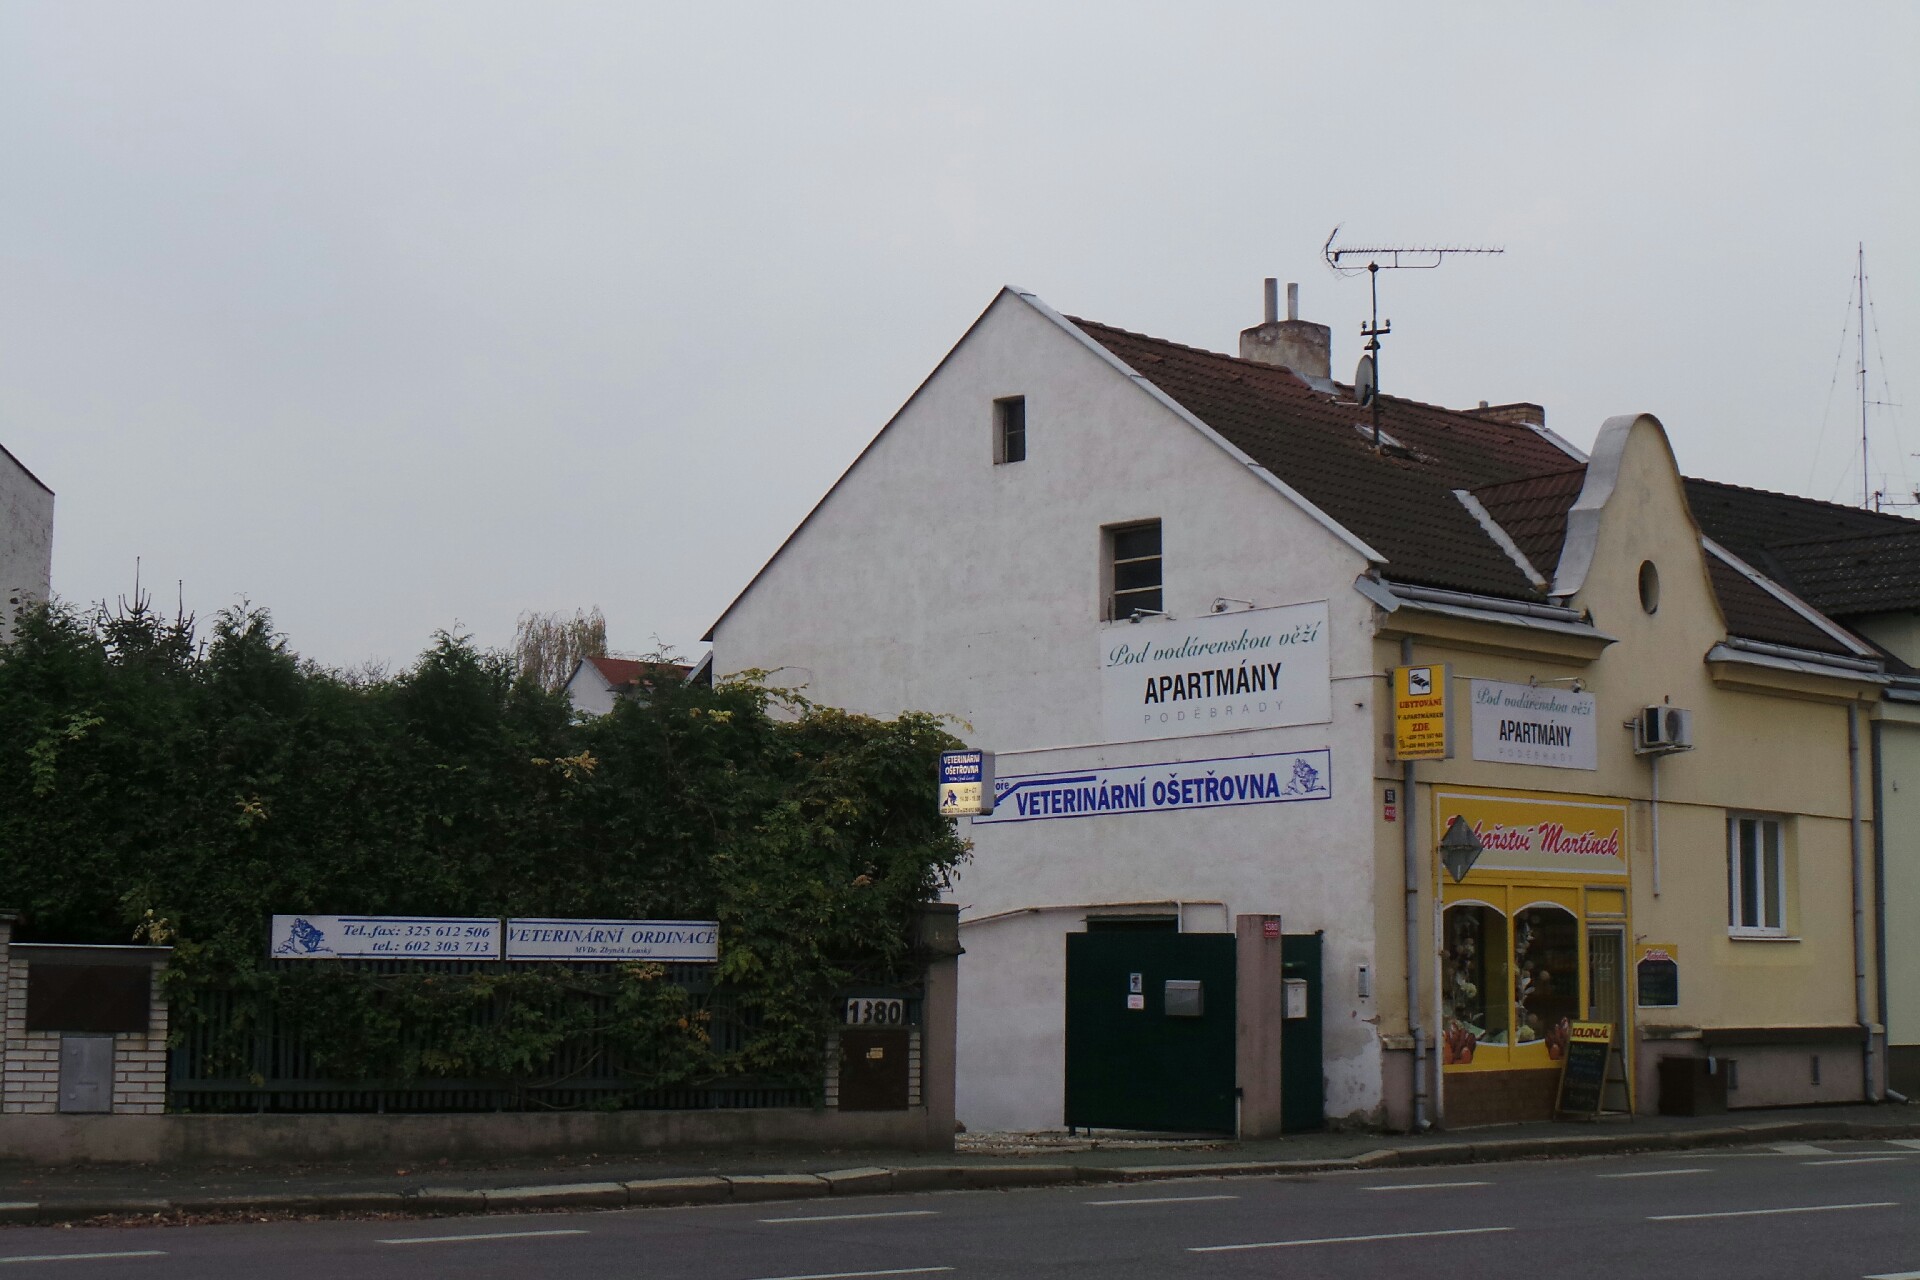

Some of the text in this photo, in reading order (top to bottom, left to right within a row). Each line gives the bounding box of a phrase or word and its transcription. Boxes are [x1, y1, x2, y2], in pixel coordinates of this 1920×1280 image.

[1107, 621, 1321, 667] Pod vodárenskou věží
[1144, 659, 1282, 704] APARTMÁNY
[1144, 700, 1283, 725] PODĚBRADY
[1412, 723, 1430, 732] ZDE
[1499, 719, 1572, 747] APARTMÁNY
[943, 753, 980, 764] VETERINÁRNÍ
[945, 764, 979, 775] OŠETŘOVNA
[1016, 770, 1281, 816] VETERINÁRNÍ OŠETŘOVNA
[1538, 821, 1619, 856] Martínek
[405, 926, 431, 937] 325
[436, 926, 460, 937] 612
[464, 927, 490, 938] 506
[508, 927, 717, 944] VETERINÁRNÍ ORDINACE
[373, 940, 489, 952] tel.: 602 303 713
[849, 1001, 901, 1024] 1380
